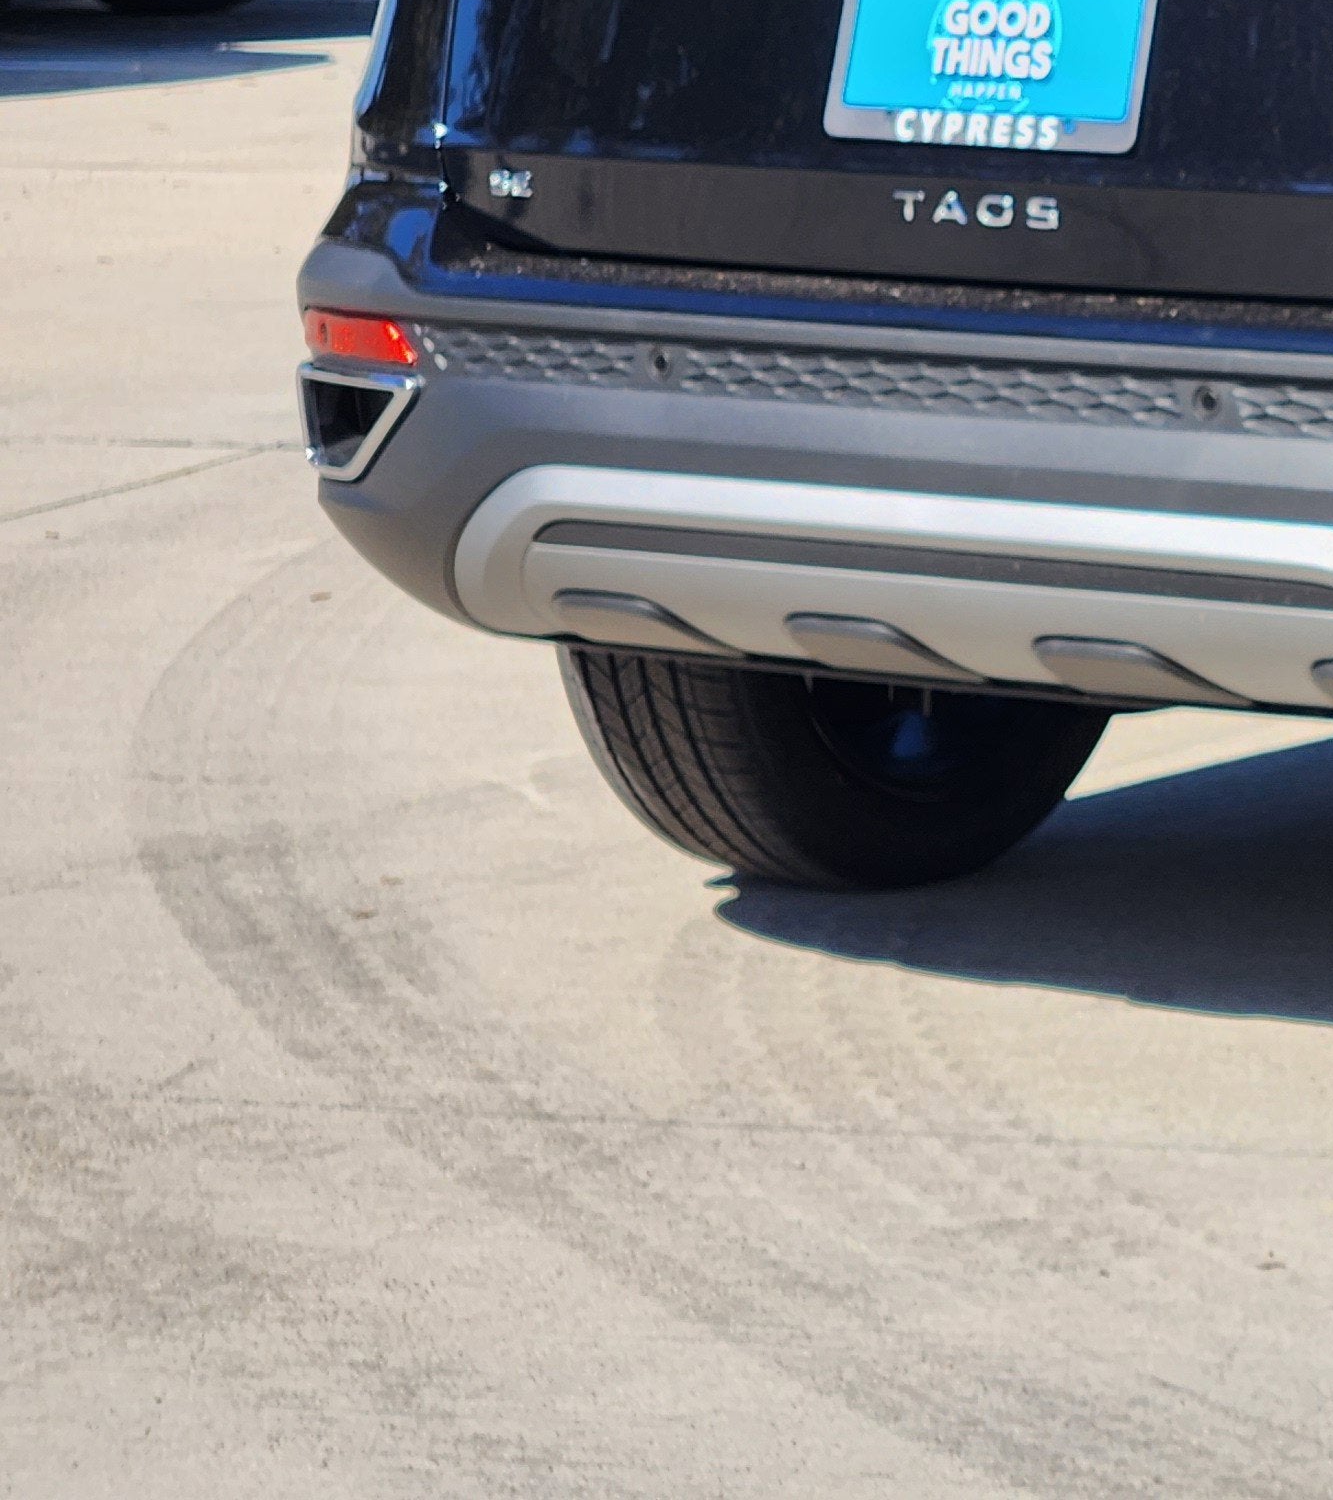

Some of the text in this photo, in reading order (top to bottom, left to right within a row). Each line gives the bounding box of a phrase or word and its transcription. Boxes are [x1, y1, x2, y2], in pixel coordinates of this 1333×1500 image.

[945, 0, 1051, 40] GOOD
[931, 37, 1053, 80] THINGS
[896, 108, 1058, 150] CYPRESS
[893, 190, 1060, 230] TAOS
